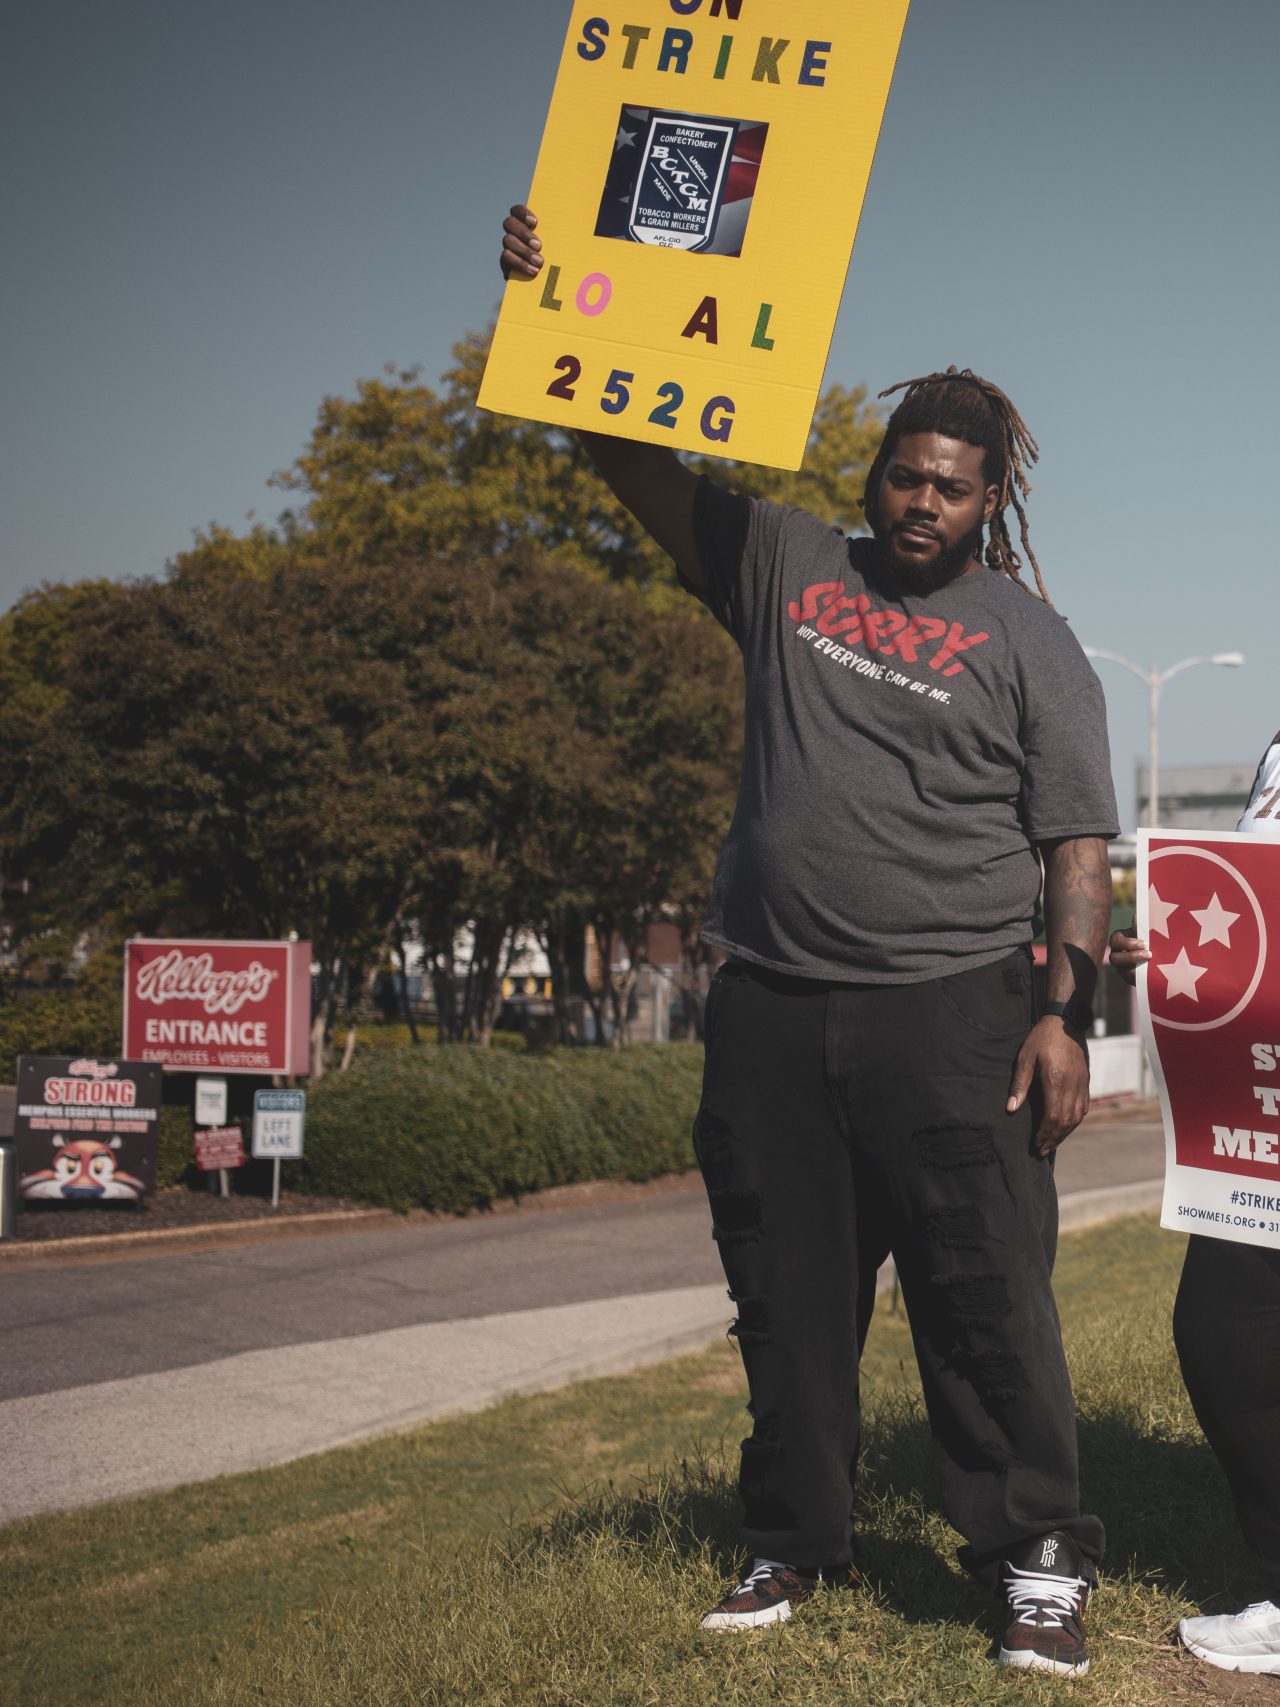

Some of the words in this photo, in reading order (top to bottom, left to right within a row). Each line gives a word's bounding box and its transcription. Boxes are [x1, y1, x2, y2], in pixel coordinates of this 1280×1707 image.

[577, 17, 832, 87] STRIKE
[660, 135, 718, 150] CONFECTIONERY
[675, 127, 705, 139] BAKERY
[651, 145, 709, 212] BCTGM
[689, 155, 708, 181] UNION
[653, 177, 671, 202] MADE
[638, 207, 671, 219] TOBACCO
[673, 212, 706, 224] WORKERS
[640, 216, 646, 224] &
[647, 218, 669, 228] GRAIN
[671, 221, 700, 232] MILLERS
[653, 235, 681, 244] AFL-CIO
[546, 354, 736, 443] 252G
[797, 624, 818, 641] NOT
[814, 637, 886, 680] EVERYONE
[885, 670, 909, 687] CAN
[909, 681, 929, 693] BE
[928, 688, 952, 705] ME.
[136, 949, 274, 1015] Kellogg's
[146, 1019, 268, 1047] ENTRANCE
[142, 1048, 209, 1067] EMPLOYEES
[218, 1050, 270, 1067] VISITORS
[45, 1077, 137, 1108] STRONG
[263, 1118, 292, 1132] LEFT
[262, 1133, 292, 1149] LANE
[1177, 1205, 1256, 1229] SHOWME15.ORG
